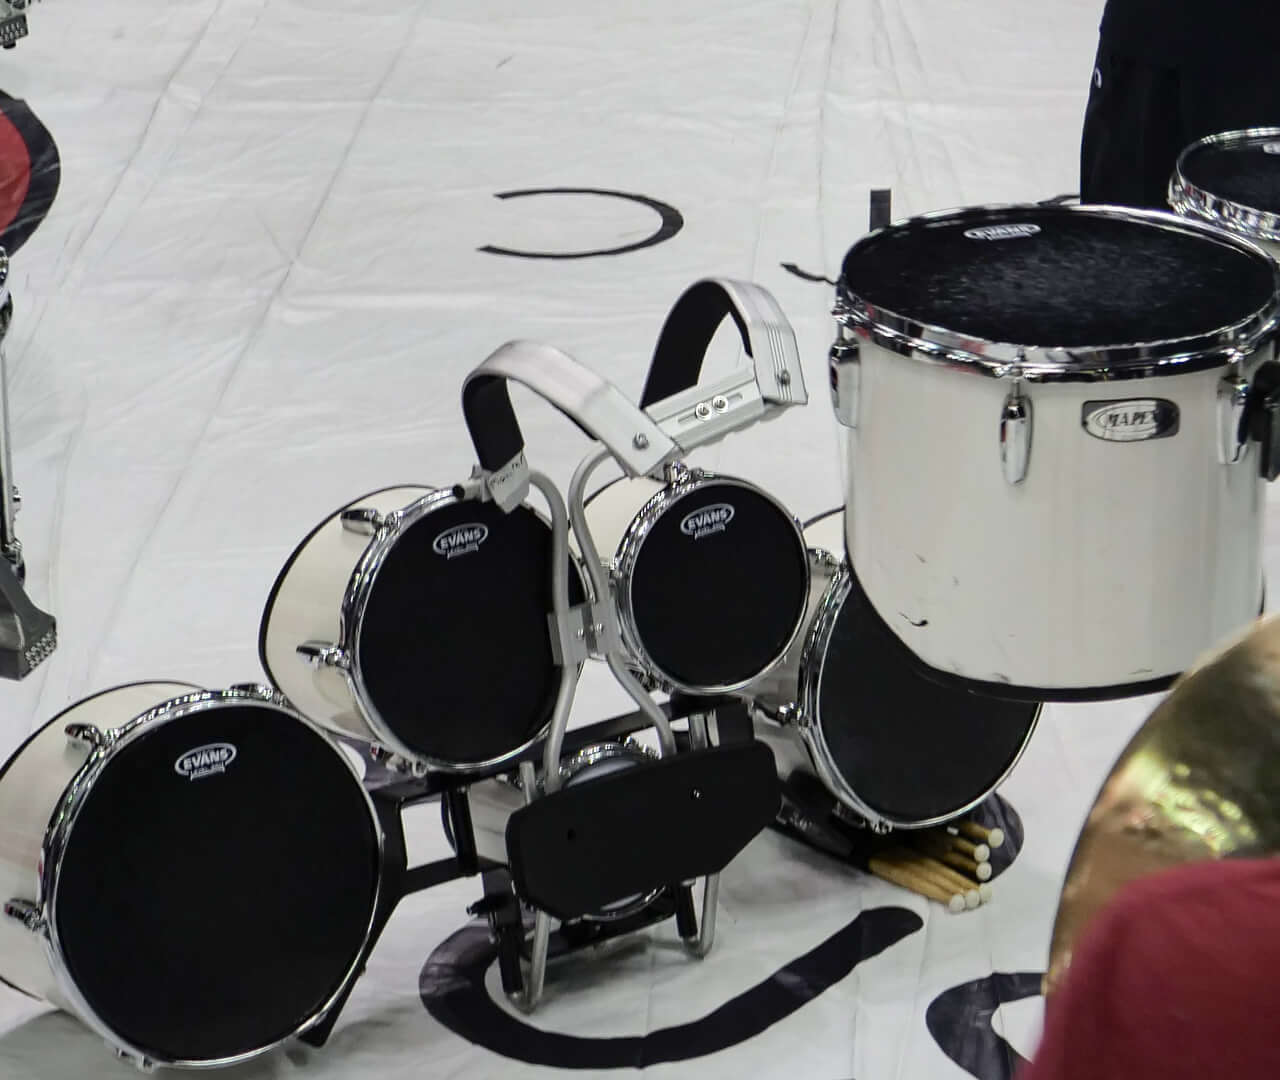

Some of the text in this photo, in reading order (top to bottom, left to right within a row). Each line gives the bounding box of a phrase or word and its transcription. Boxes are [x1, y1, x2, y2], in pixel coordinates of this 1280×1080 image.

[688, 508, 727, 531] EVANS
[440, 528, 481, 550] EVANS
[183, 747, 229, 772] EVANS
